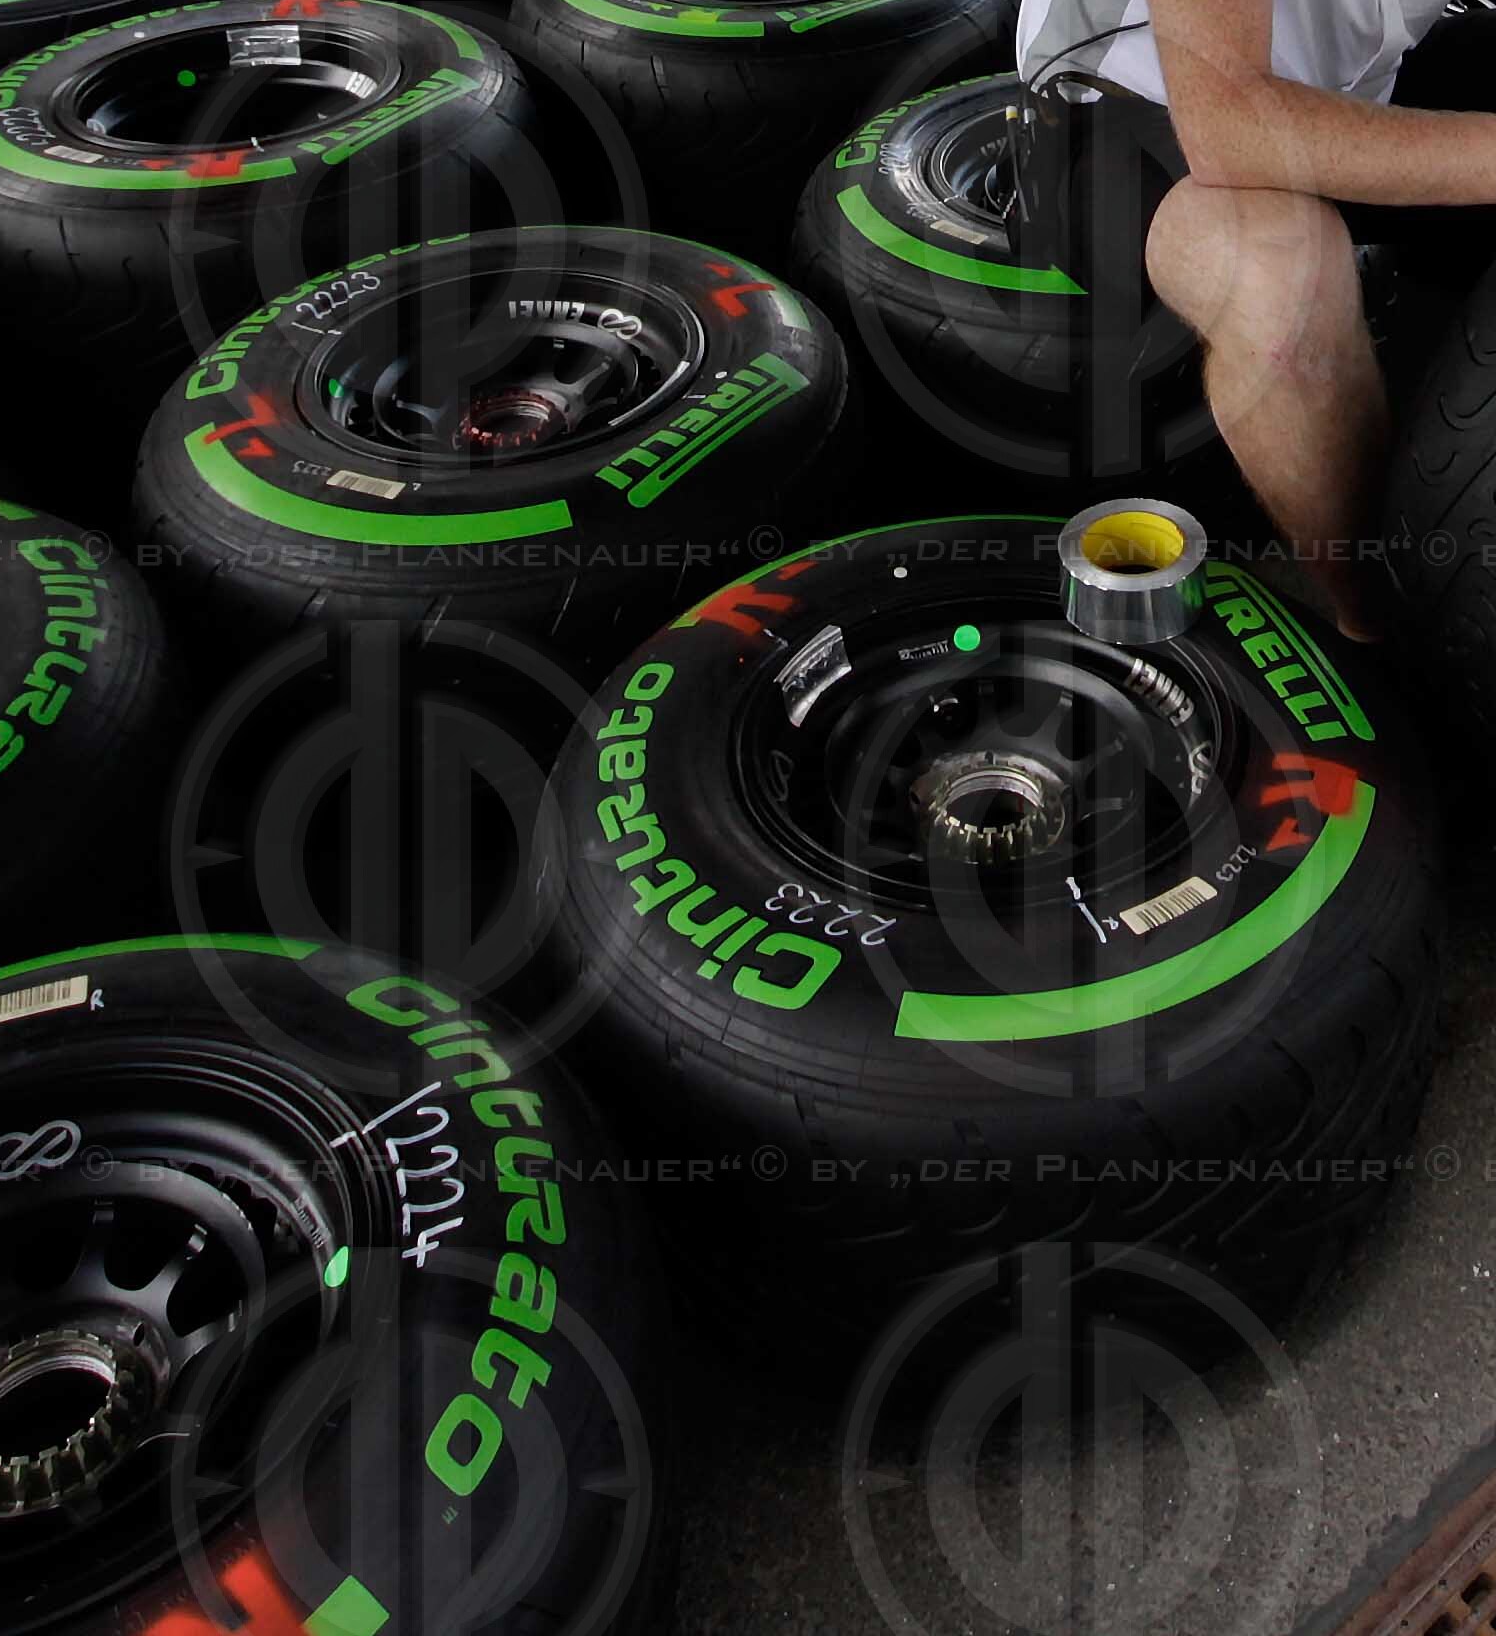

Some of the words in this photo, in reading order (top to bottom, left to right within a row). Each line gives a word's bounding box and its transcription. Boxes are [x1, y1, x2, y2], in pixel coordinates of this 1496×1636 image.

[294, 270, 382, 320] 2223
[595, 350, 811, 509] PIRELLI
[764, 882, 899, 948] 2223
[89, 986, 105, 1012] R
